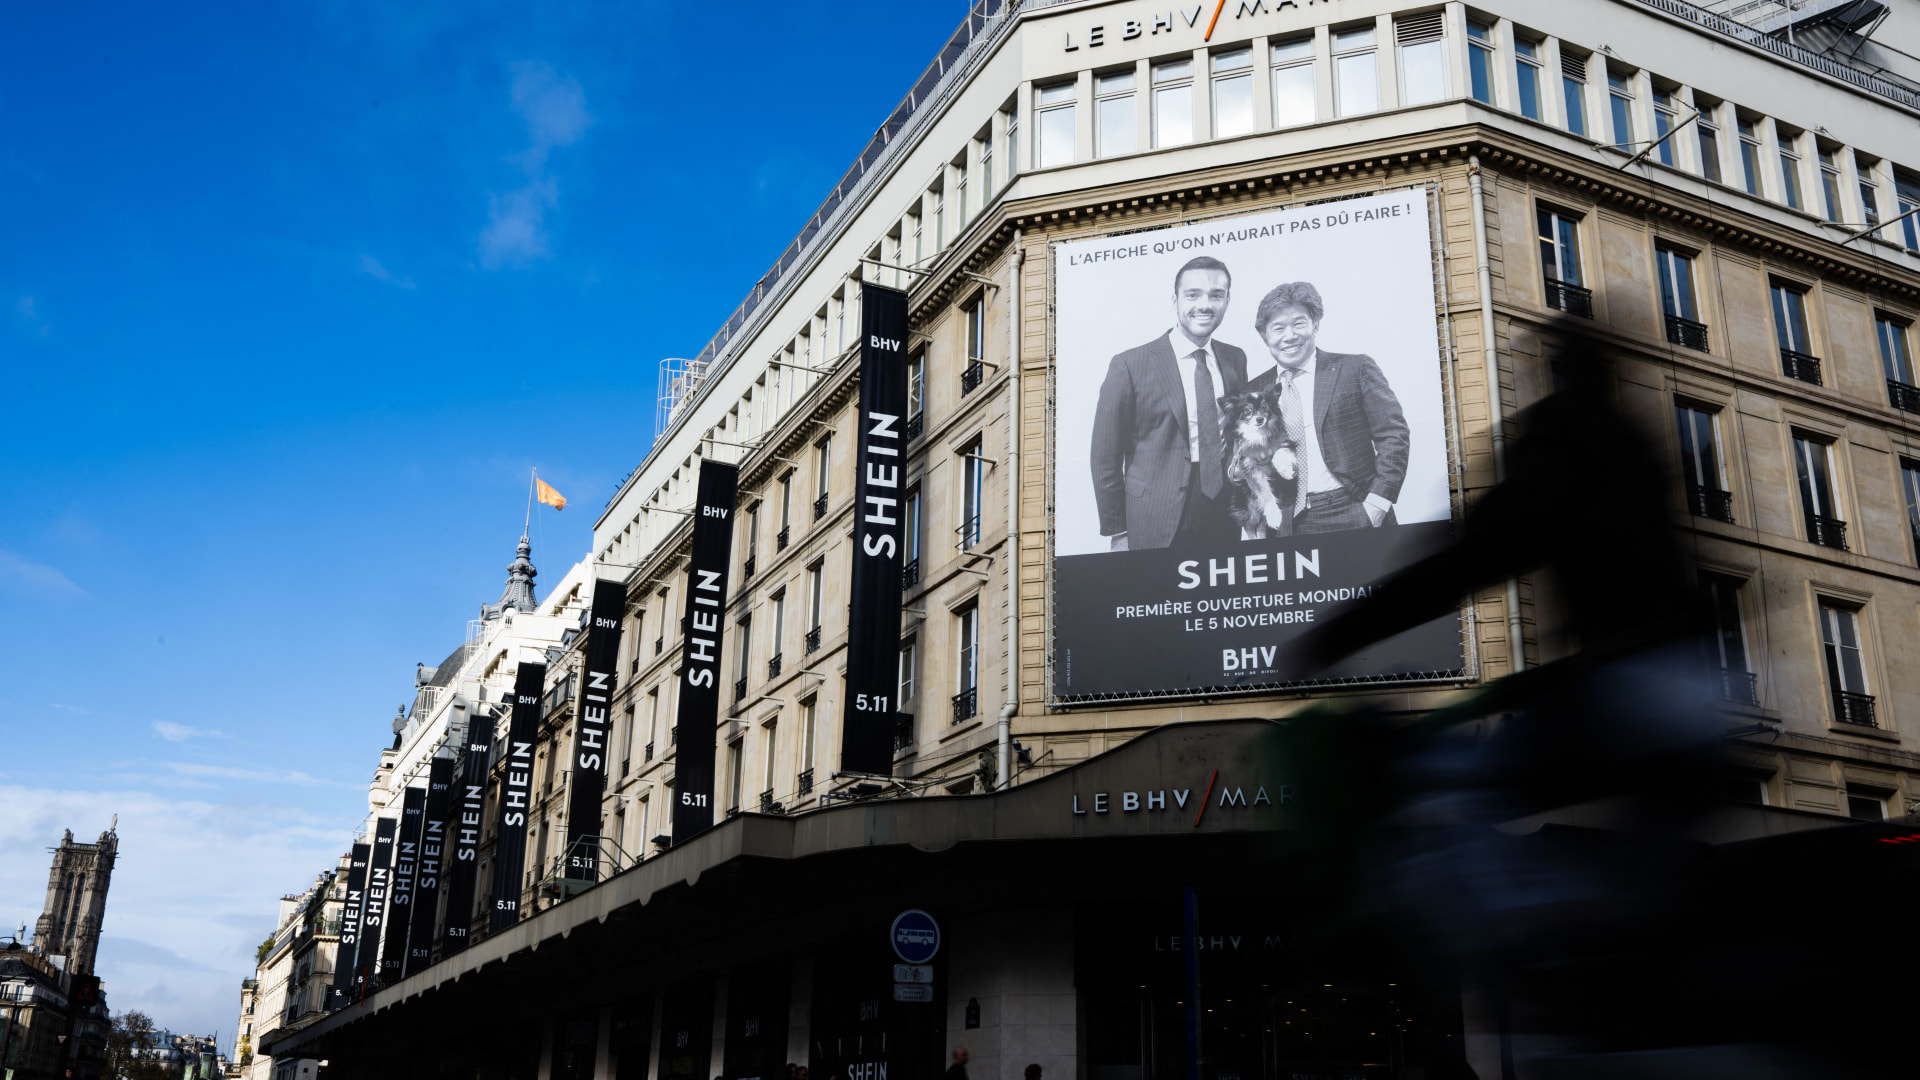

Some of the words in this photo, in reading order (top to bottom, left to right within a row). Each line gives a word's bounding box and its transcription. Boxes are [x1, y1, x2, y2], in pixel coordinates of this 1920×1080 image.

[1064, 26, 1104, 52] LE
[1121, 4, 1201, 41] BHV
[1070, 244, 1148, 266] L’AFFICHE
[1153, 235, 1205, 254] QU’ON
[1209, 223, 1285, 246] N’AURAIT
[1290, 218, 1321, 233] PAS
[1326, 211, 1349, 228] DÛ
[1354, 205, 1401, 223] FAIRE
[870, 335, 901, 352] BHV
[862, 411, 900, 560] SHEIN
[702, 505, 729, 520] BHV
[1177, 548, 1321, 590] SHEIN
[1116, 599, 1193, 619] PREMIÈRE
[1196, 592, 1295, 613] OUVERTURE
[595, 617, 617, 630] BHV
[688, 569, 722, 690] SHEIN
[1185, 618, 1204, 632] LE
[1208, 617, 1218, 630] 5
[1223, 609, 1315, 630] NOVEMBRE
[1222, 645, 1277, 671] BHV
[518, 695, 538, 705] BHV
[855, 693, 888, 713] 5.11
[579, 670, 610, 771] SHEIN
[470, 743, 488, 753] BHV
[432, 782, 448, 791] BHV
[504, 741, 532, 827] SHEIN
[681, 791, 707, 808] 5.11
[1073, 792, 1108, 814] LE
[1123, 788, 1190, 812] BHV
[406, 808, 421, 816] BHV
[458, 785, 483, 862] SHEIN
[377, 836, 392, 844] BHV
[420, 819, 443, 889] SHEIN
[572, 856, 593, 869] 5.11
[394, 841, 416, 905] SHEIN
[366, 867, 388, 927] SHEIN
[496, 899, 516, 911] 5.11
[342, 890, 362, 945] SHEIN
[449, 927, 466, 938] 5.11
[412, 948, 428, 958] 5.11
